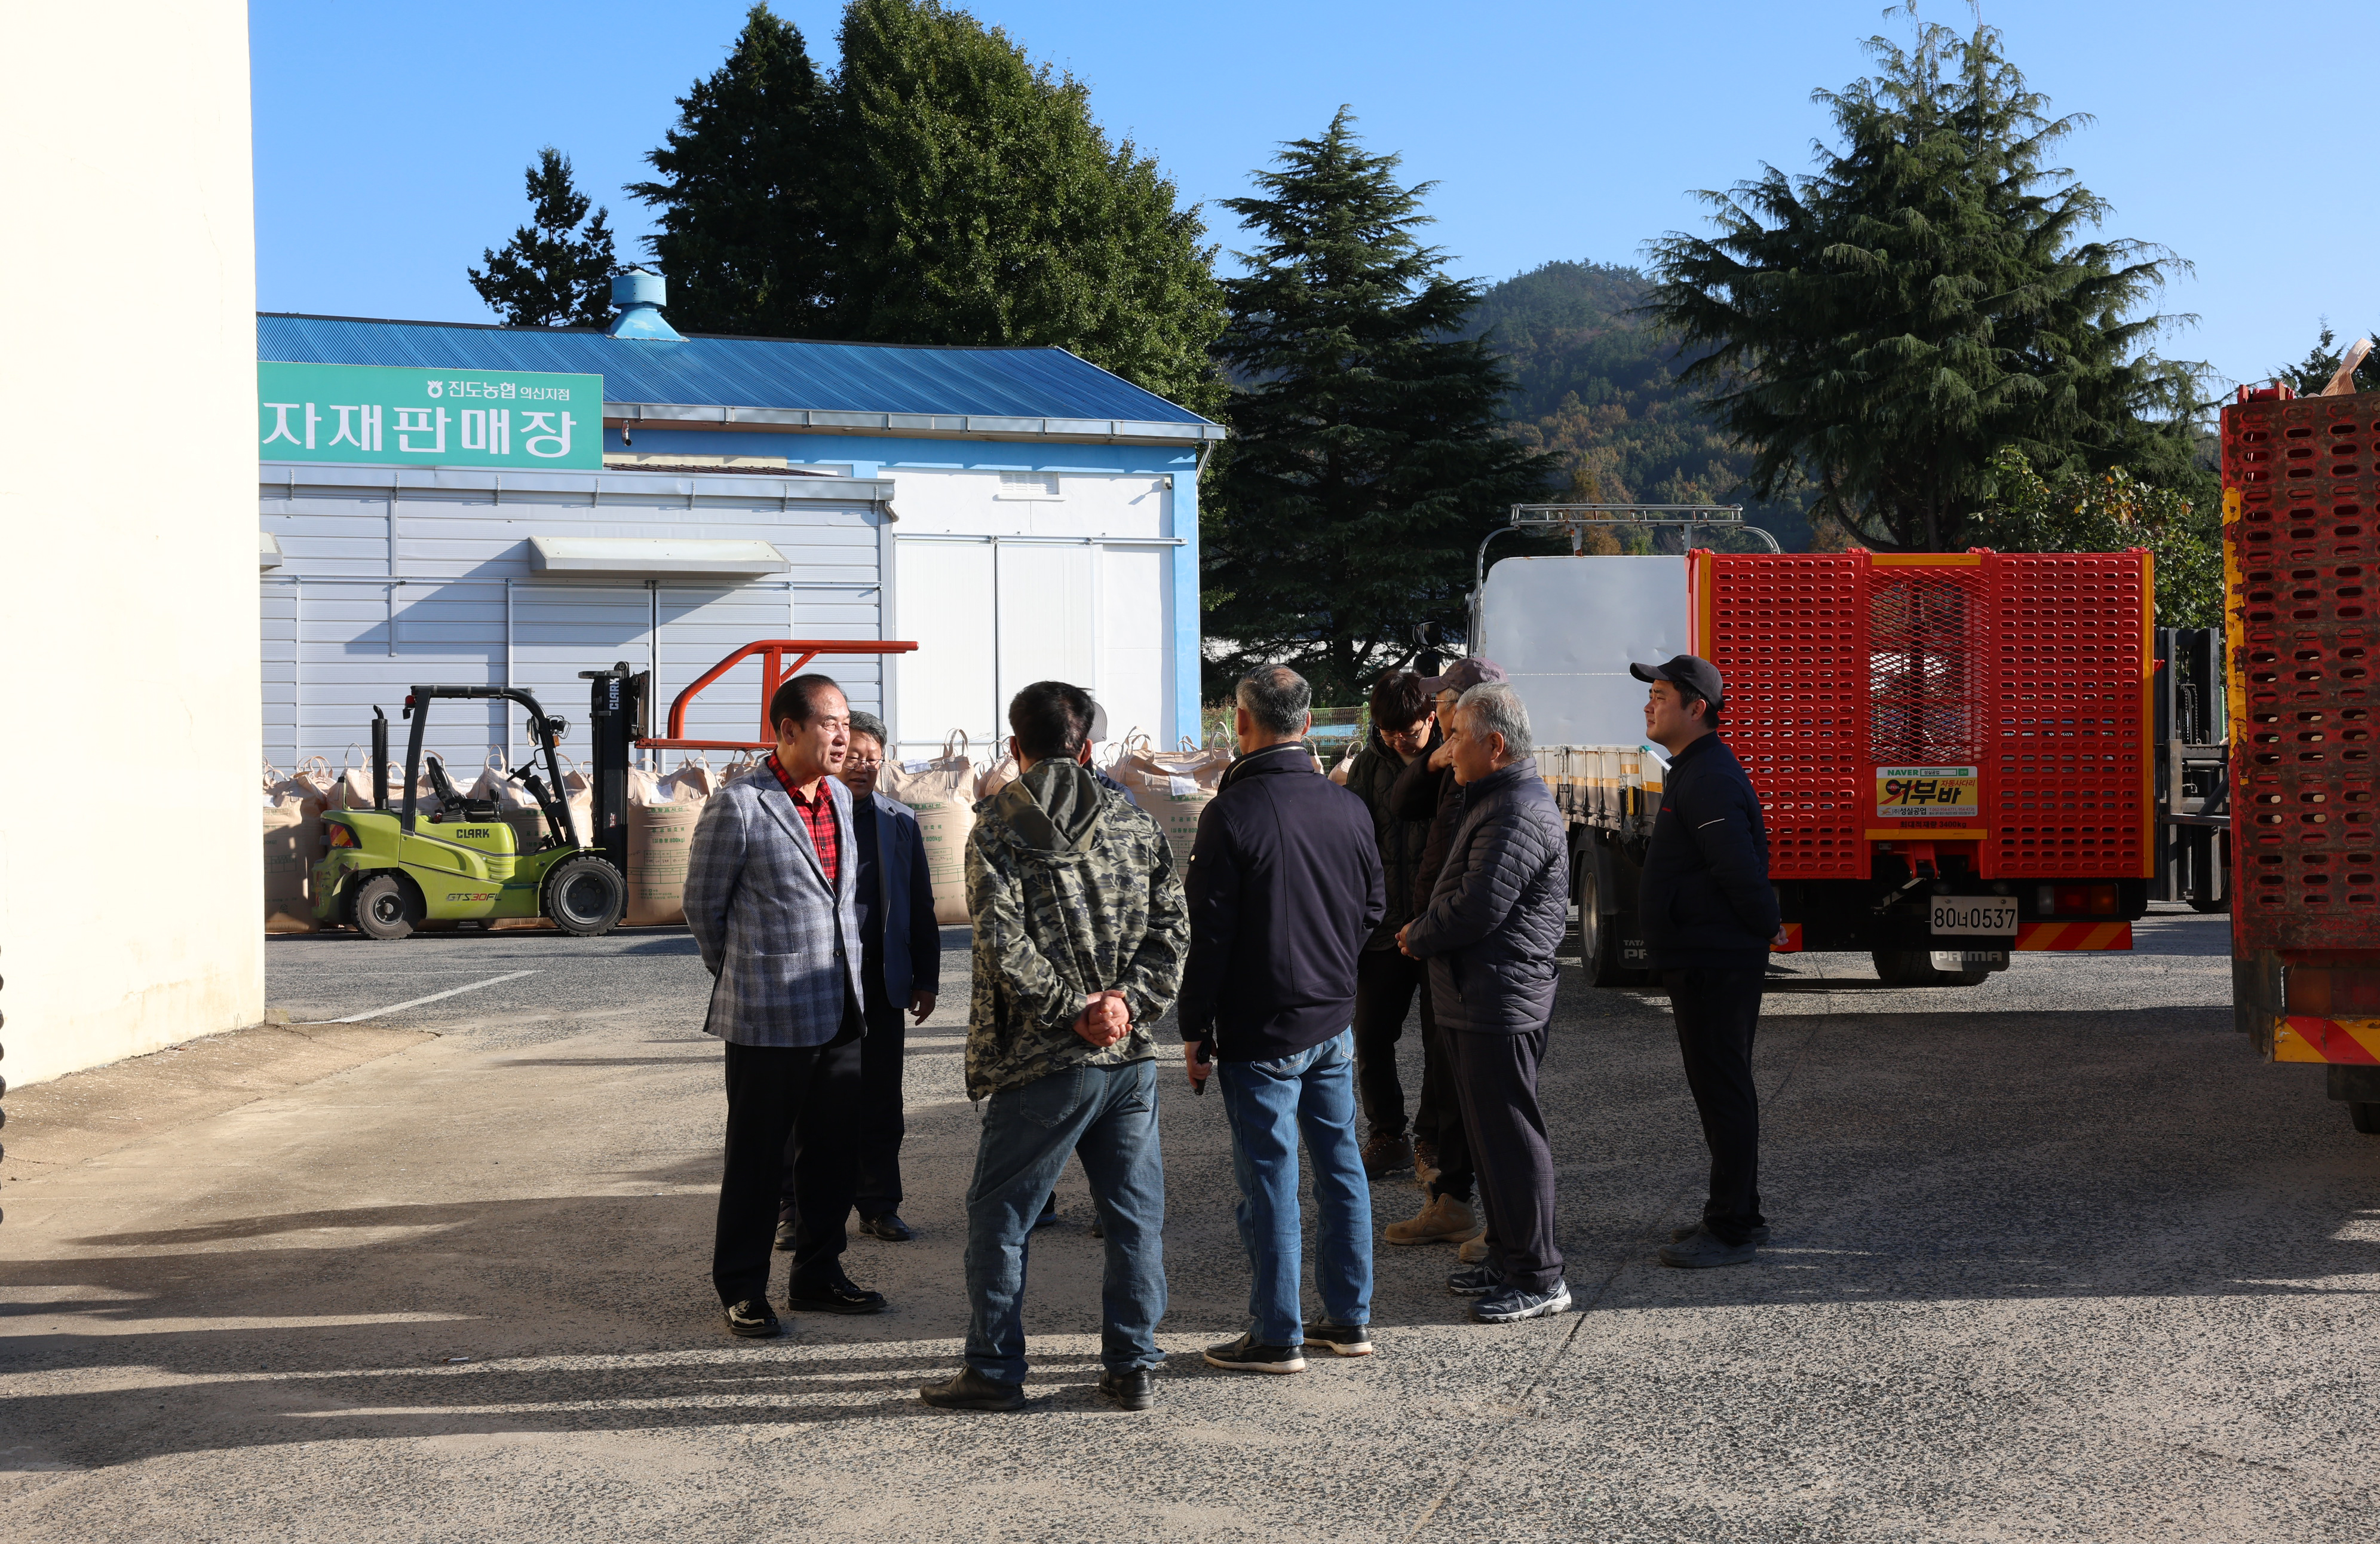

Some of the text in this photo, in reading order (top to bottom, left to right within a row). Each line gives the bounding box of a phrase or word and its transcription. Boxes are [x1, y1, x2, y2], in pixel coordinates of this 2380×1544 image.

[447, 381, 570, 402] 진도농협 의신지점
[262, 402, 577, 458] 자재판매장
[609, 678, 619, 710] CLARK
[456, 829, 490, 838] CLARK
[1934, 908, 2016, 929] 80너0537
[1935, 951, 2002, 961] PRIMA
